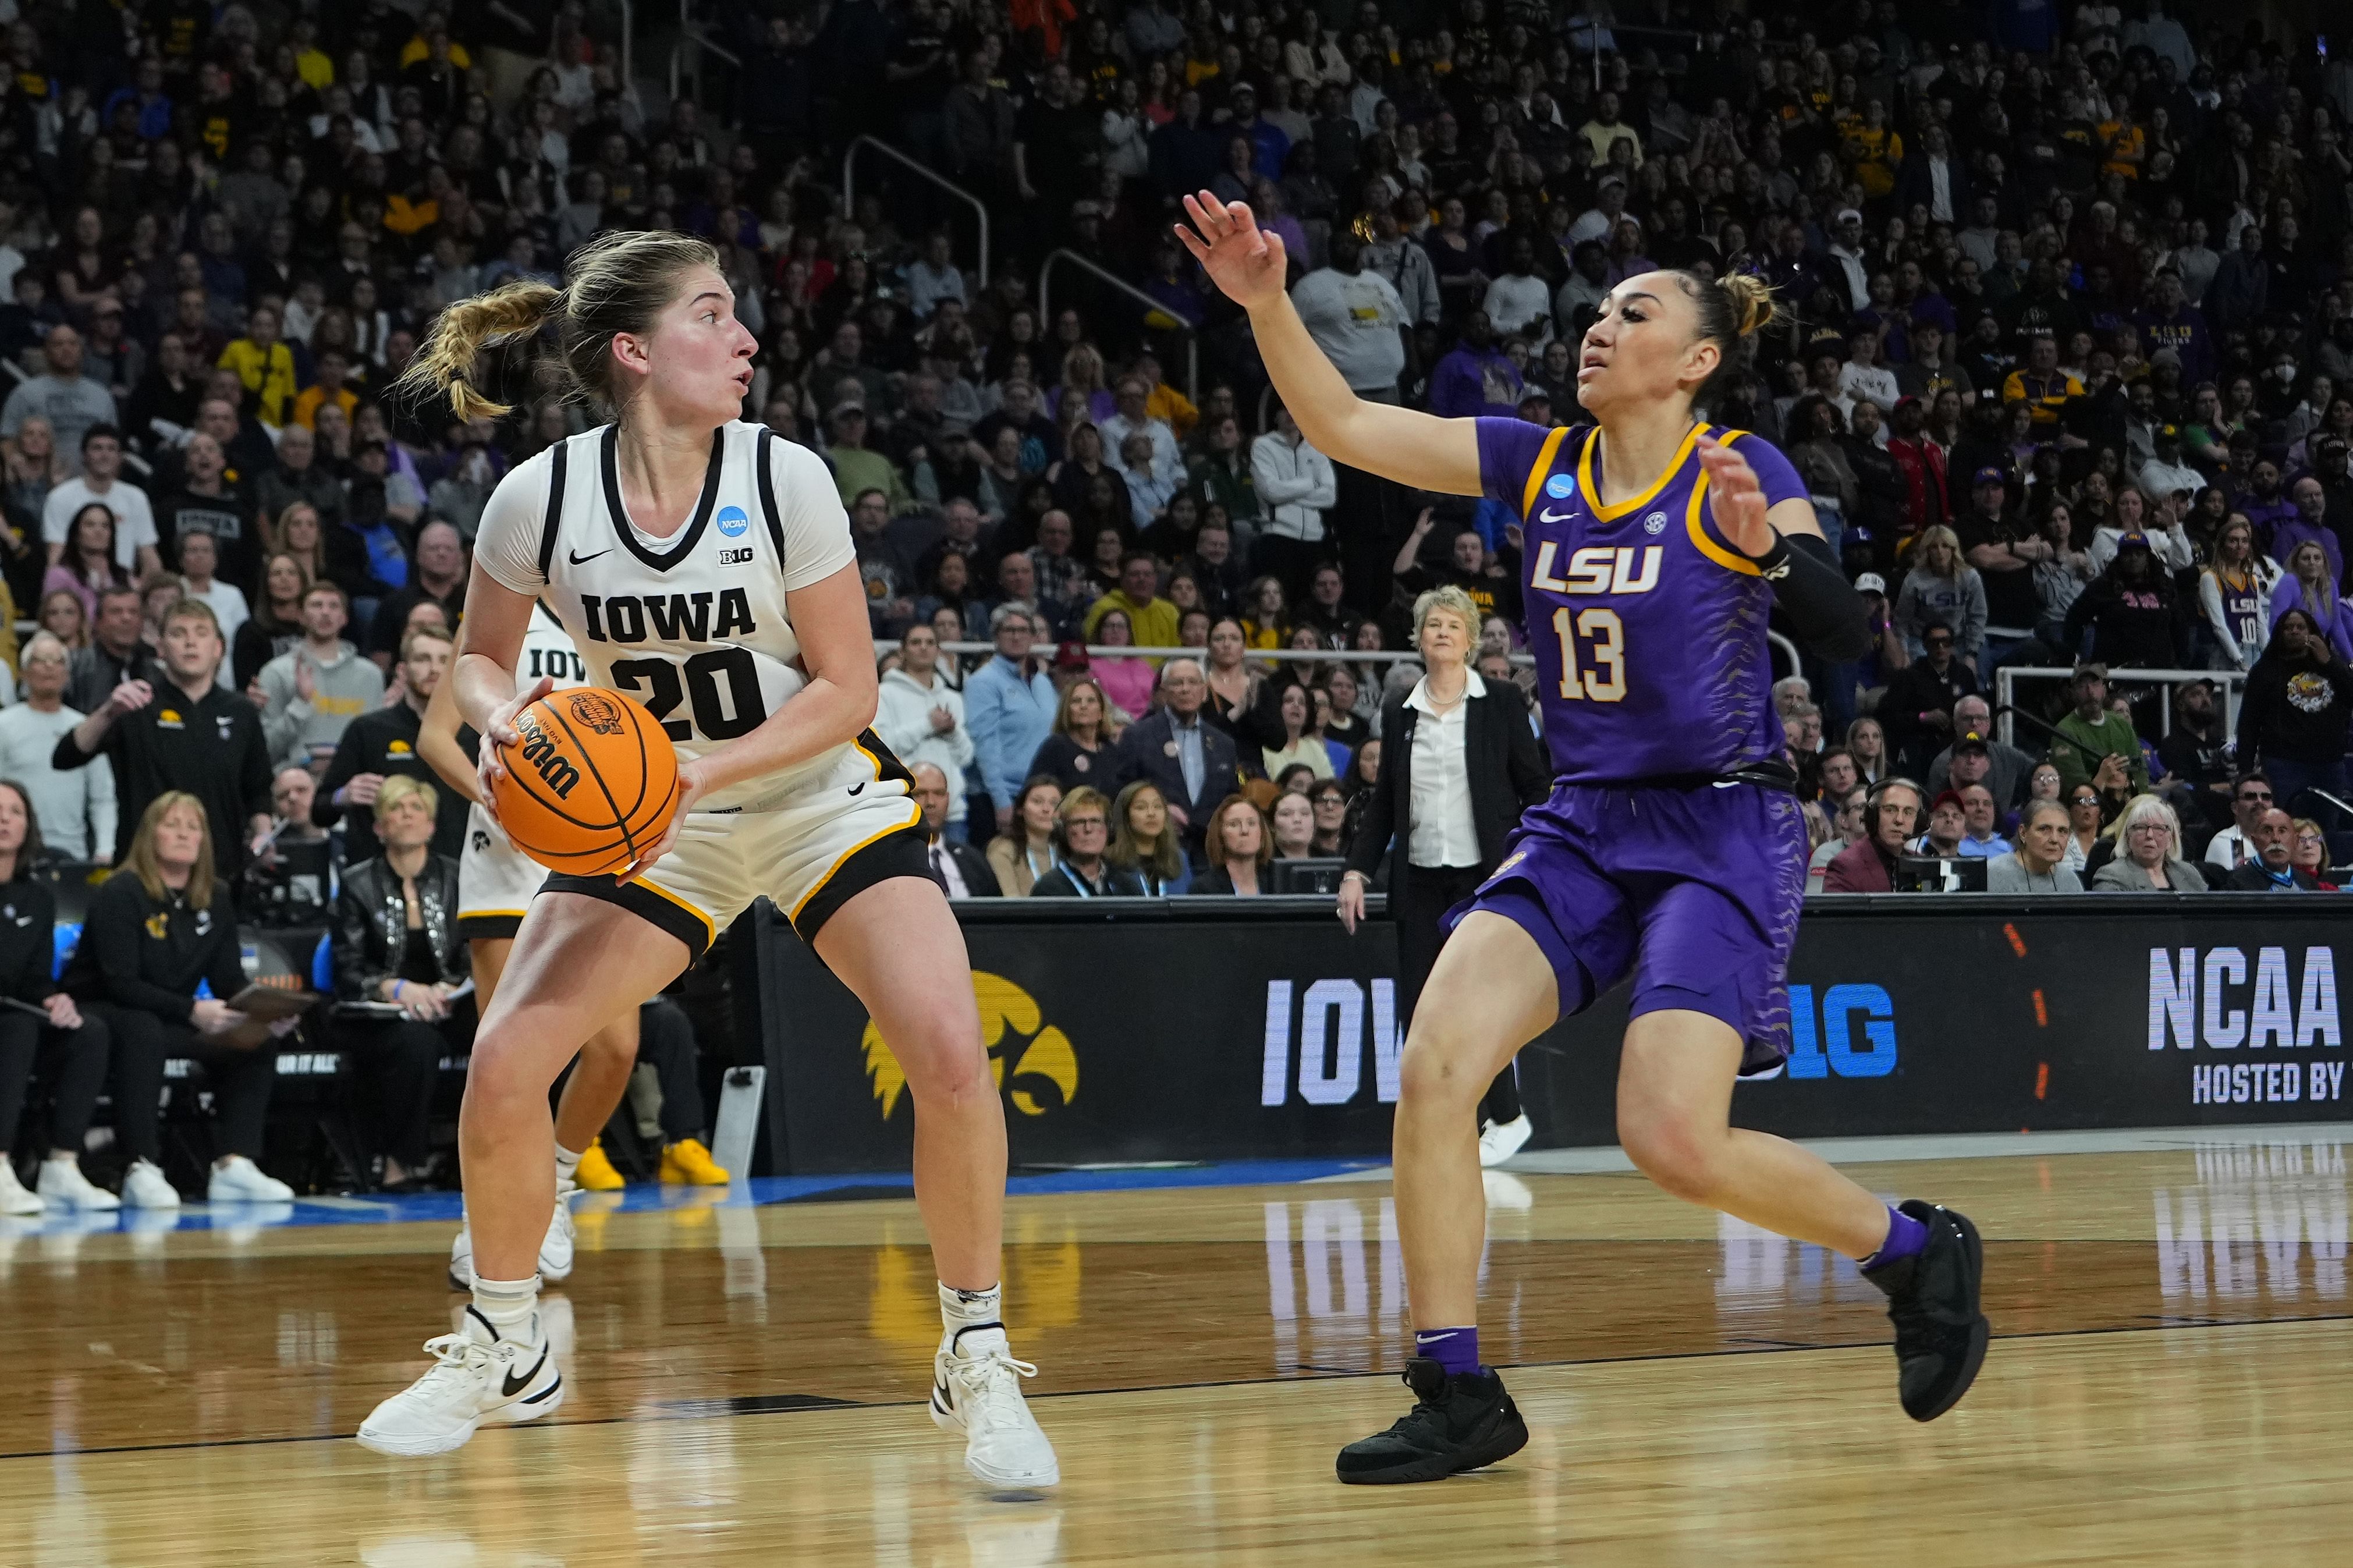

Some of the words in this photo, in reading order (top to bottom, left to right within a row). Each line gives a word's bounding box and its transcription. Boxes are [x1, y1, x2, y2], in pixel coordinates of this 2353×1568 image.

[722, 519, 747, 529] NCAA
[1531, 541, 1664, 594] LSU
[581, 587, 757, 643] IOWA
[2230, 598, 2258, 613] LSU
[2240, 618, 2257, 644] 10
[1552, 607, 1627, 703] 13
[610, 647, 768, 742] 20
[516, 707, 580, 801] Wilson
[2148, 946, 2341, 1050] NCAA
[2192, 1063, 2300, 1104] HOSTED
[2309, 1061, 2345, 1101] BY
